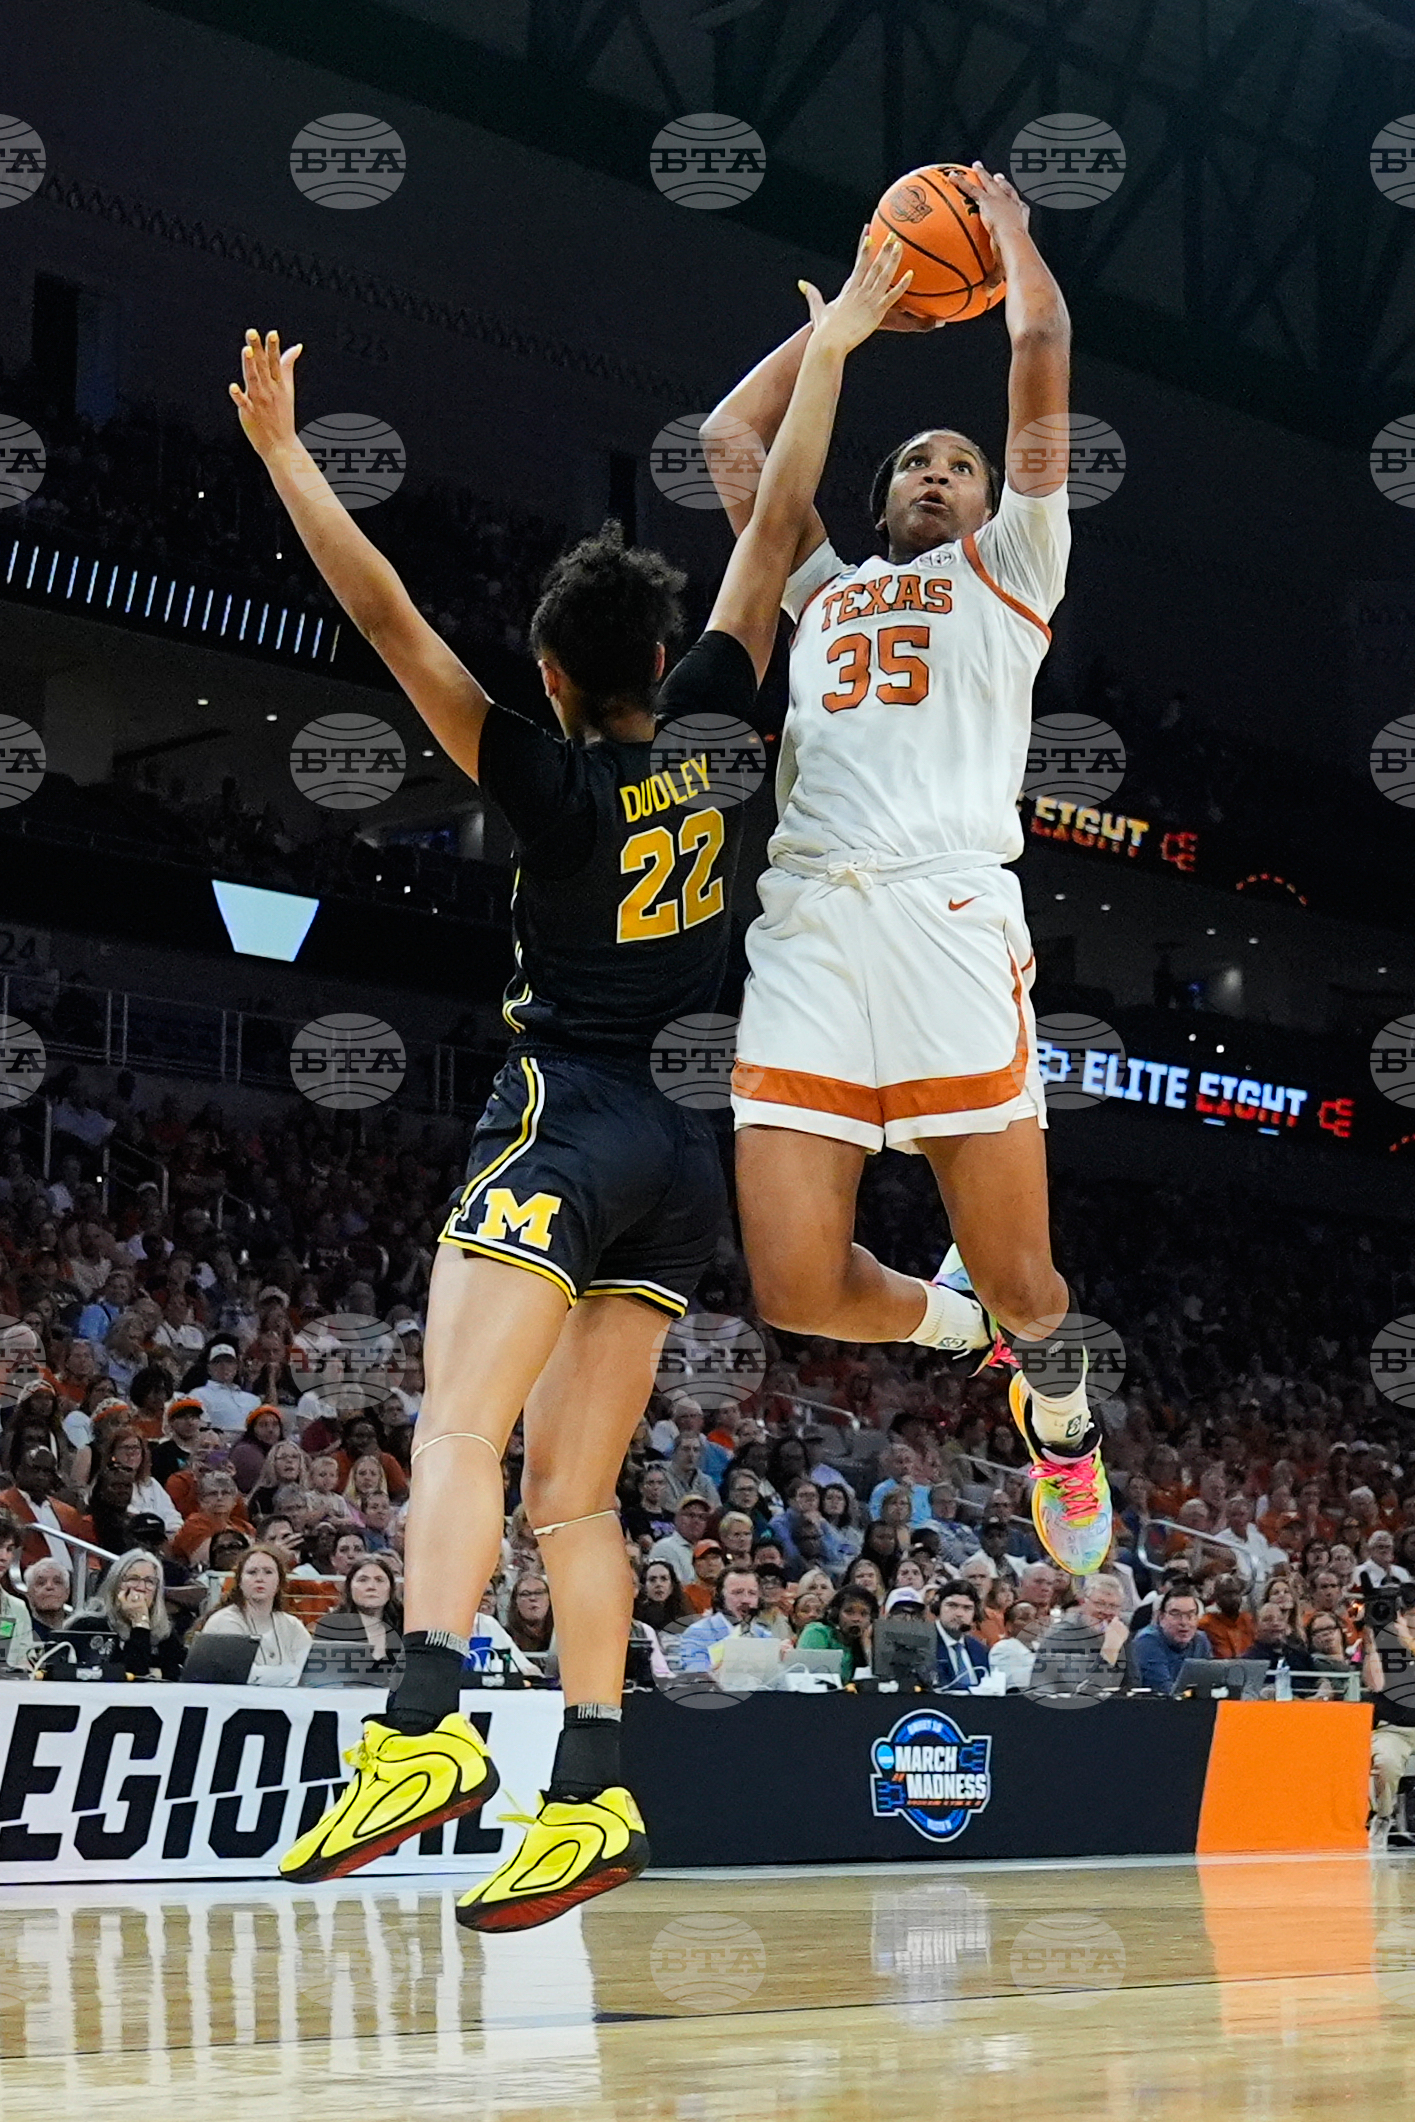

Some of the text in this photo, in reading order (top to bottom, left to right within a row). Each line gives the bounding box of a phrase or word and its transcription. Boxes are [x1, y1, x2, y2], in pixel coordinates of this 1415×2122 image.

[822, 574, 953, 633] TEXAS
[822, 624, 930, 714] 35
[619, 753, 711, 823] DUDLEY
[616, 806, 725, 944] 22
[1082, 1049, 1191, 1110] ELITE
[1195, 1072, 1308, 1128] EIGHT
[476, 1188, 562, 1251] M
[894, 1745, 958, 1772] MARCH
[905, 1773, 987, 1800] MADNESS
